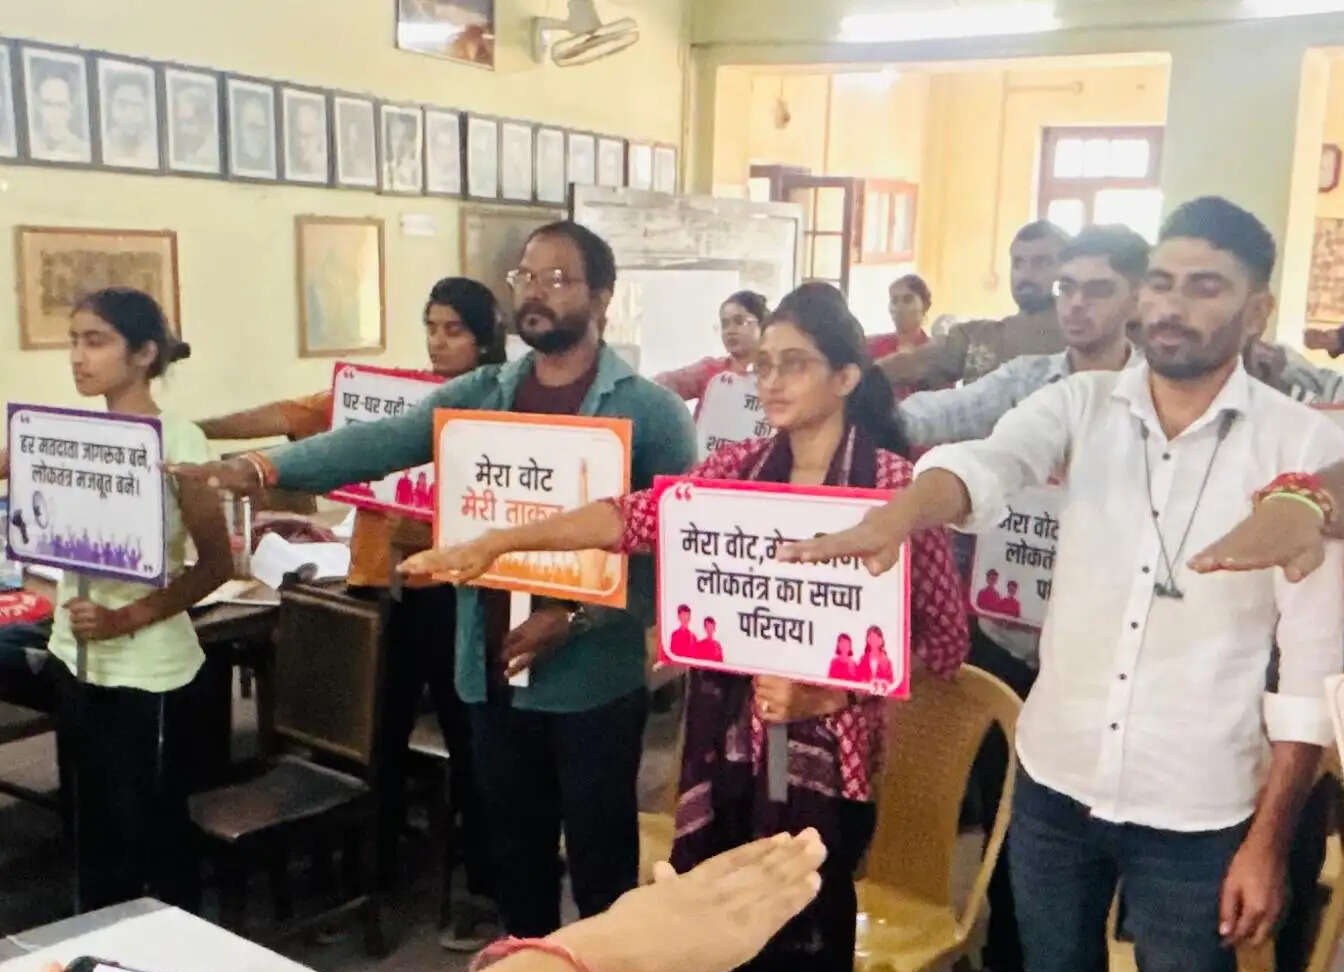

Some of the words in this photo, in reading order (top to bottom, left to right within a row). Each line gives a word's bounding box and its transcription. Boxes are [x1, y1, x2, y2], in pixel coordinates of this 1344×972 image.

[20, 435, 35, 454] हर
[38, 437, 80, 460] मतदाता
[31, 460, 73, 488] लोकतंत्र
[76, 469, 113, 500] मजबूत
[475, 454, 511, 488] मेरा
[519, 457, 555, 492] वोट
[461, 486, 497, 523] मेरी
[505, 499, 565, 527] ताक
[680, 522, 720, 557] मेरा
[1006, 538, 1057, 570] लोकतं
[694, 562, 772, 602] लोकतंत्र
[774, 576, 805, 605] का
[807, 580, 863, 612] सच्चा
